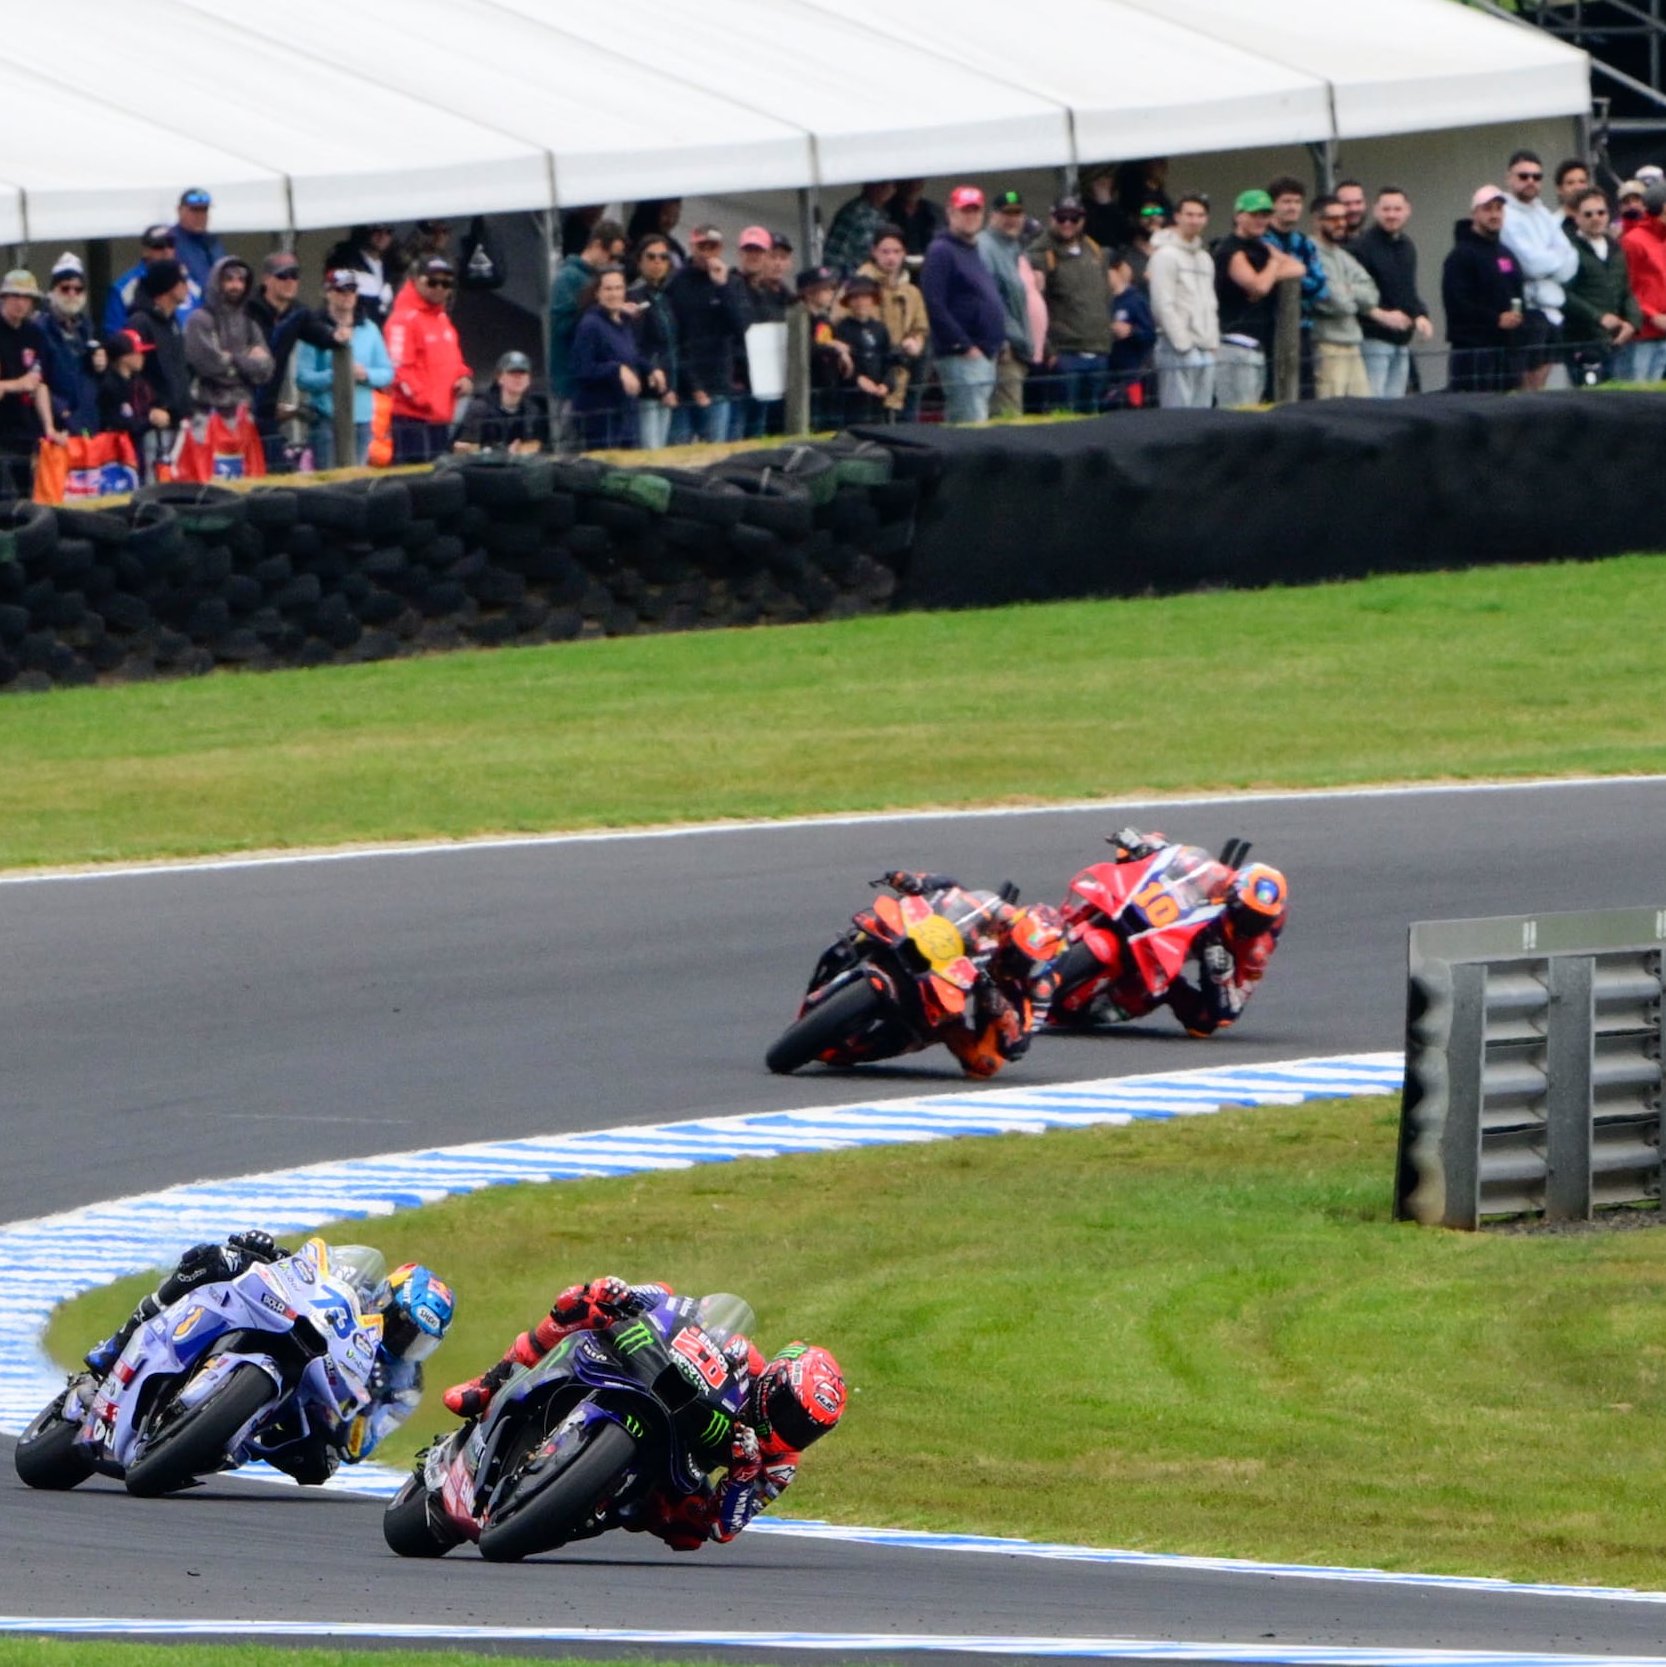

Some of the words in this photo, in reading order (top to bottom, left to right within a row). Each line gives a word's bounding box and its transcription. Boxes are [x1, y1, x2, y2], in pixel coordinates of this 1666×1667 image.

[1133, 881, 1179, 929] 10
[309, 1283, 358, 1340] 73
[698, 1332, 729, 1372] ENEOS
